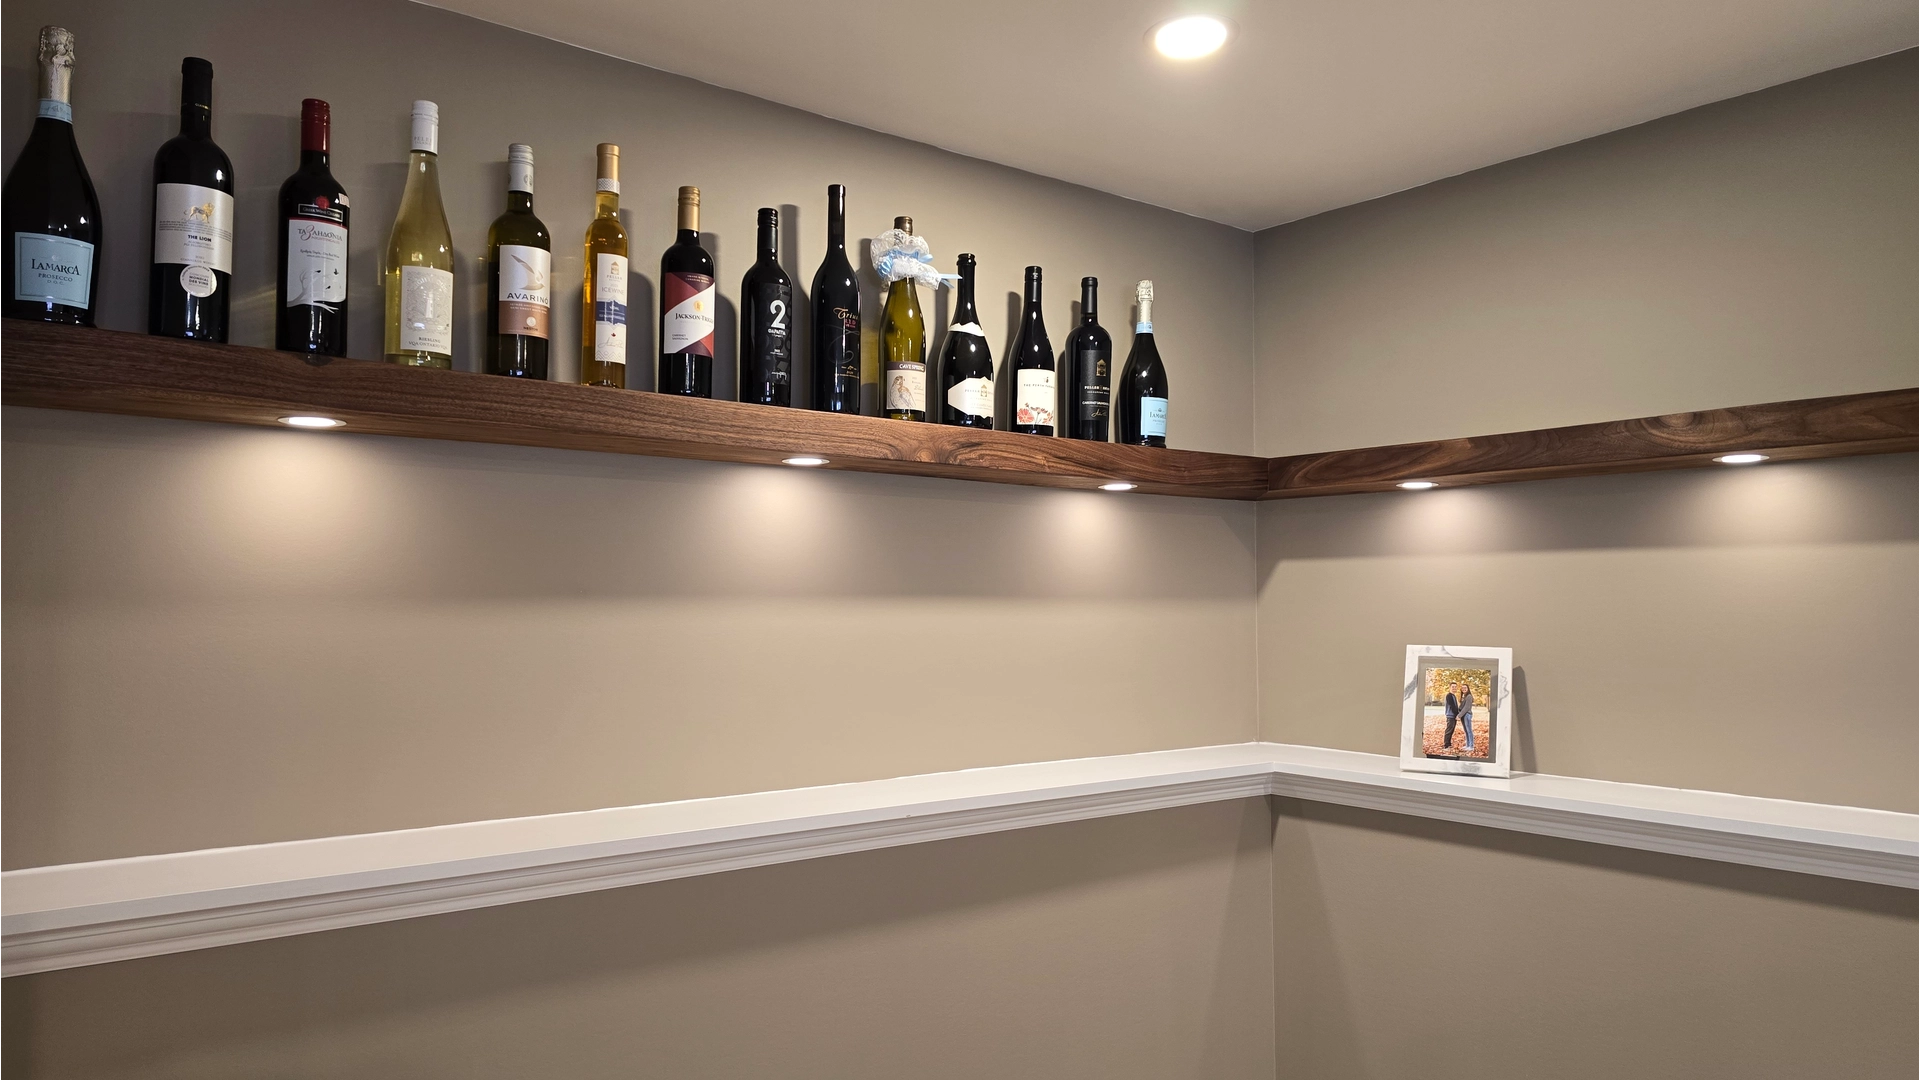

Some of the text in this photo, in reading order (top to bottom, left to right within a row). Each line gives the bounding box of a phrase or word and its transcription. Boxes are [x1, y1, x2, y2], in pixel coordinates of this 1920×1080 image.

[31, 258, 81, 277] LAMARCA
[38, 273, 73, 282] PROSECCO
[601, 286, 625, 295] ICEWINE
[770, 300, 786, 329] 2
